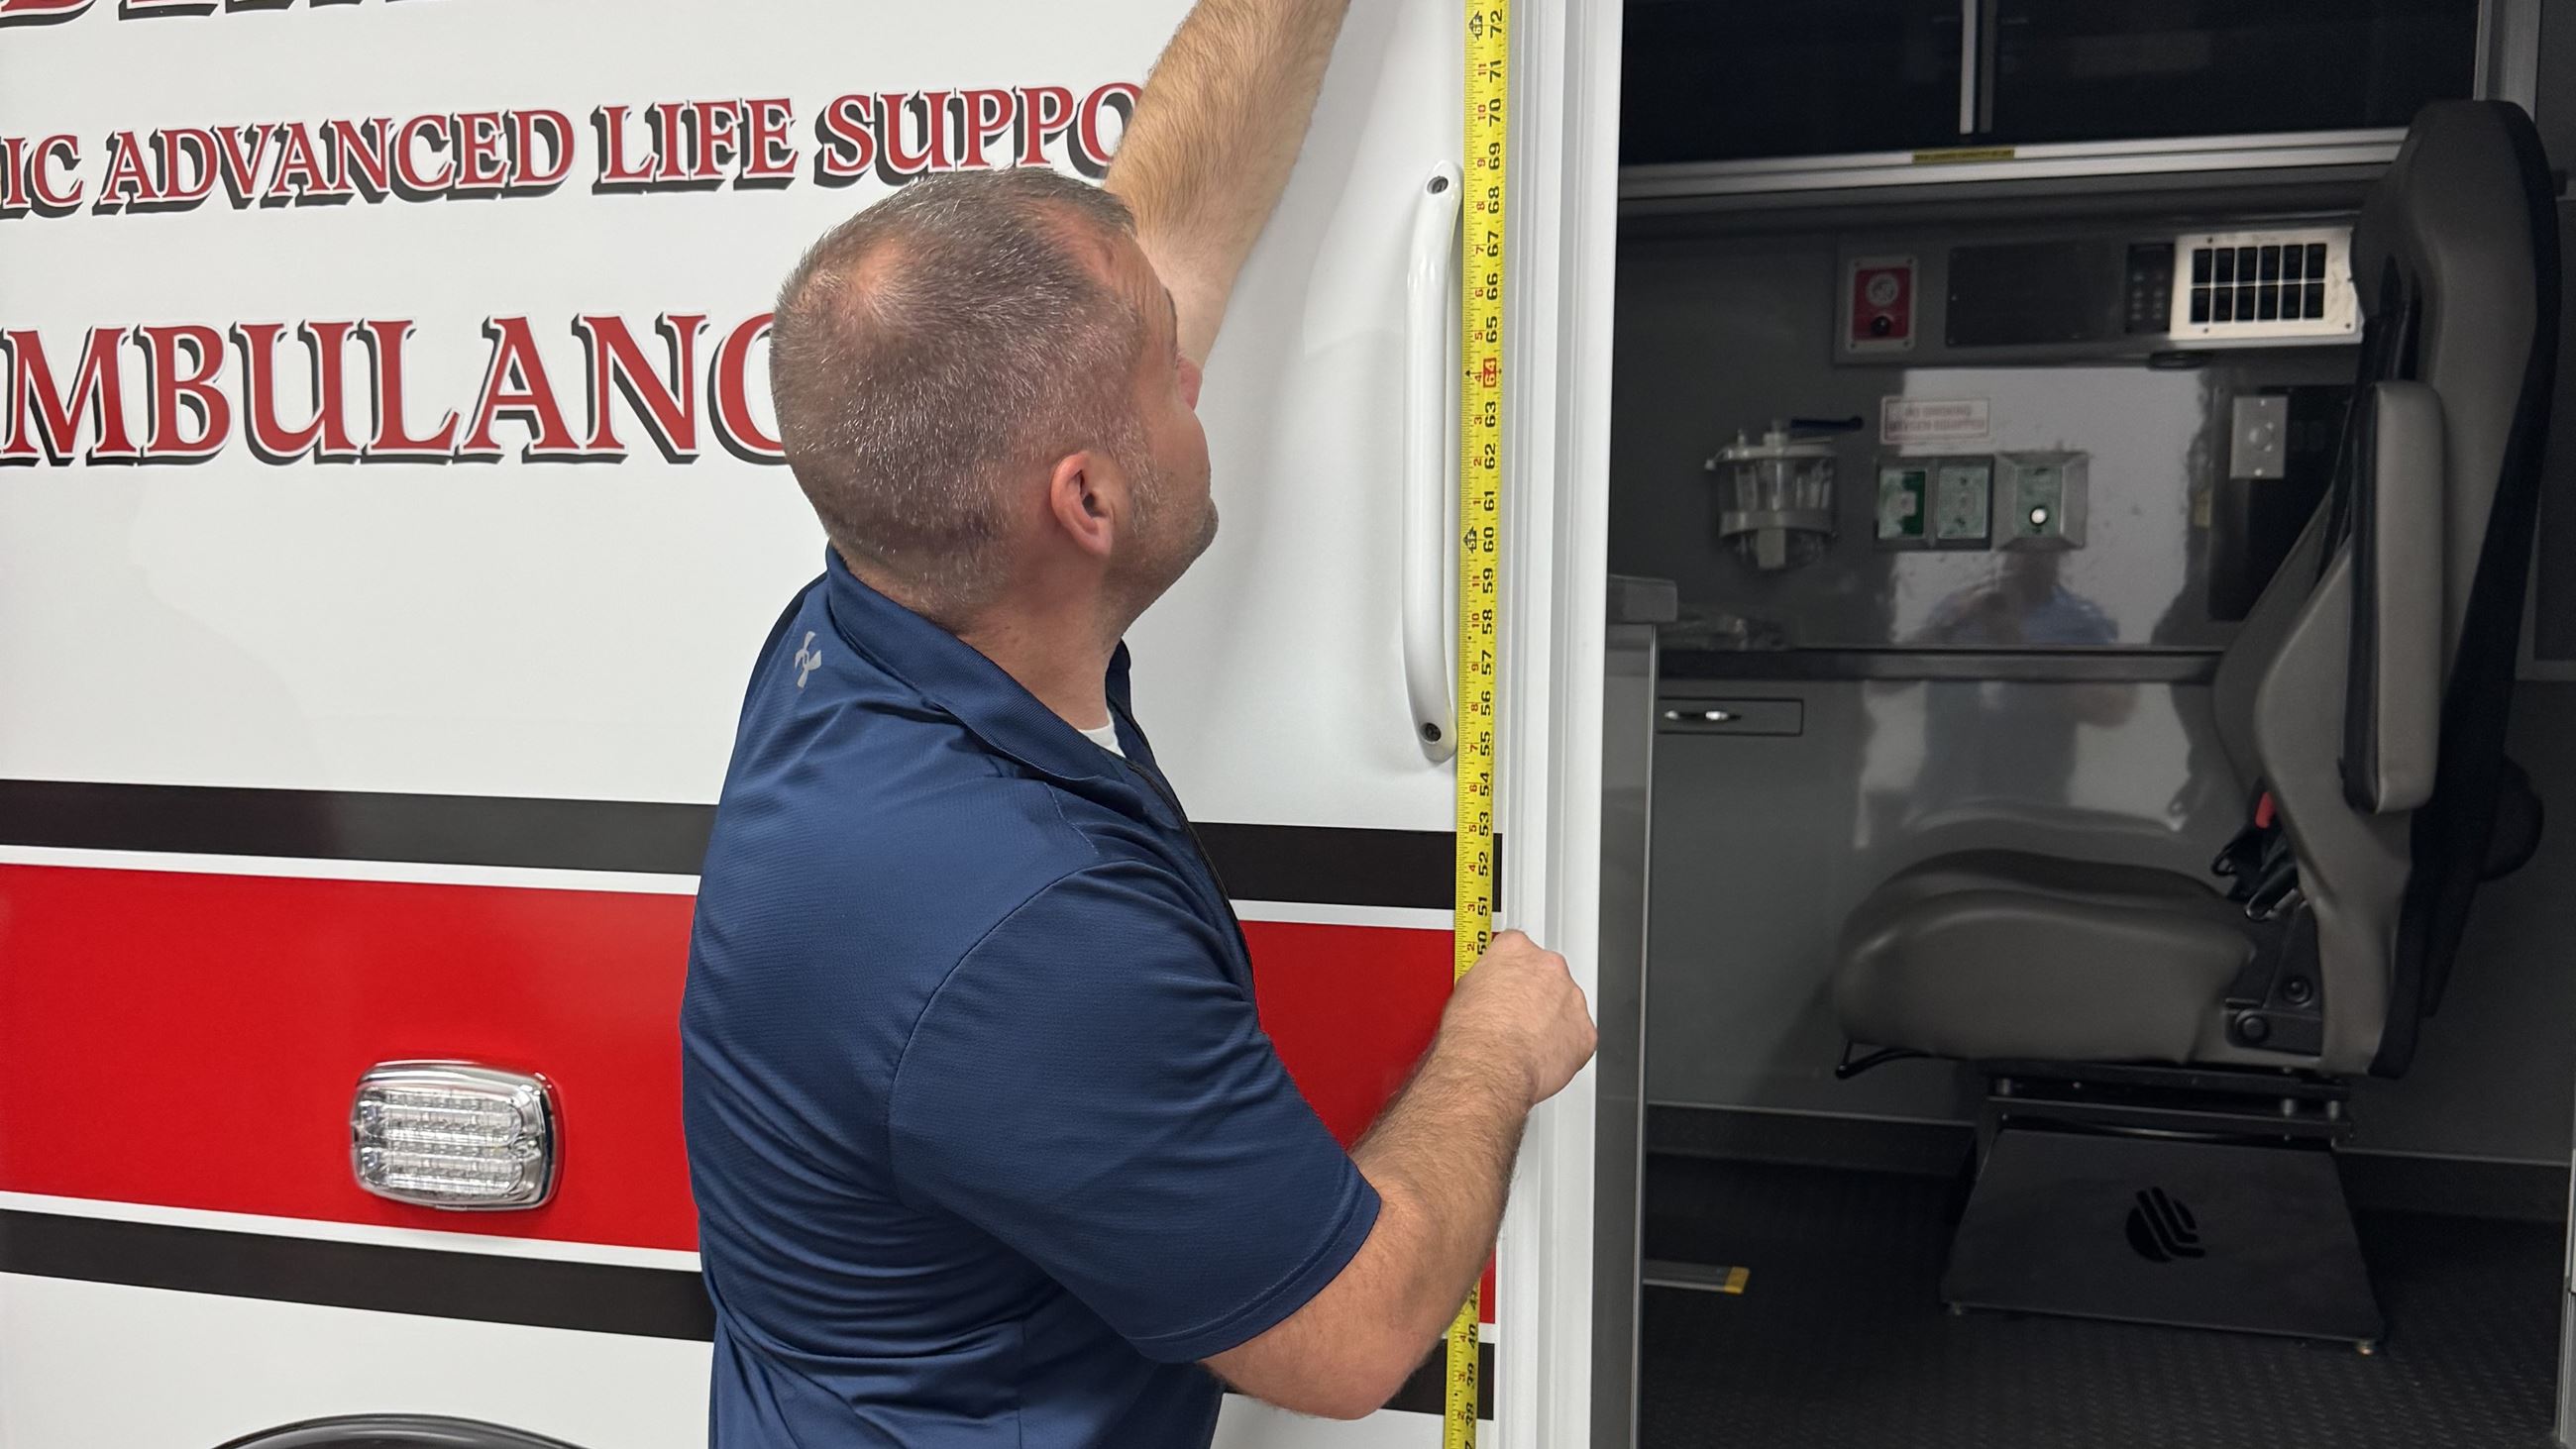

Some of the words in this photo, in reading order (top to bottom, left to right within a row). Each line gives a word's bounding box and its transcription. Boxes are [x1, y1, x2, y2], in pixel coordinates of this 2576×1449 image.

[1490, 9, 1503, 39] 72
[1477, 63, 1487, 76] 11
[1489, 59, 1502, 82] 71
[1477, 104, 1486, 121] 10
[1489, 98, 1501, 127] 70
[93, 109, 576, 215] ADVANCED
[591, 97, 799, 196] LIFE
[813, 82, 1144, 188] SUPPO
[1488, 143, 1500, 169] 69
[1488, 186, 1500, 214] 68
[1487, 231, 1499, 257] 67
[1486, 272, 1498, 300] 66
[1486, 316, 1497, 343] 65
[1484, 359, 1496, 385] 64
[1485, 401, 1496, 428] 63
[1484, 443, 1496, 469] 62
[1483, 491, 1495, 511] 61
[1483, 527, 1494, 553] 60
[1472, 575, 1480, 587] 11
[1482, 568, 1493, 593] 59
[1471, 612, 1480, 628] 10
[1482, 609, 1492, 634] 58
[1481, 650, 1492, 675] 57
[1480, 690, 1491, 716] 56
[1480, 731, 1490, 756] 55
[1479, 773, 1490, 796] 54
[1479, 811, 1489, 837] 53
[1478, 852, 1488, 877] 52
[1477, 896, 1488, 916] 51
